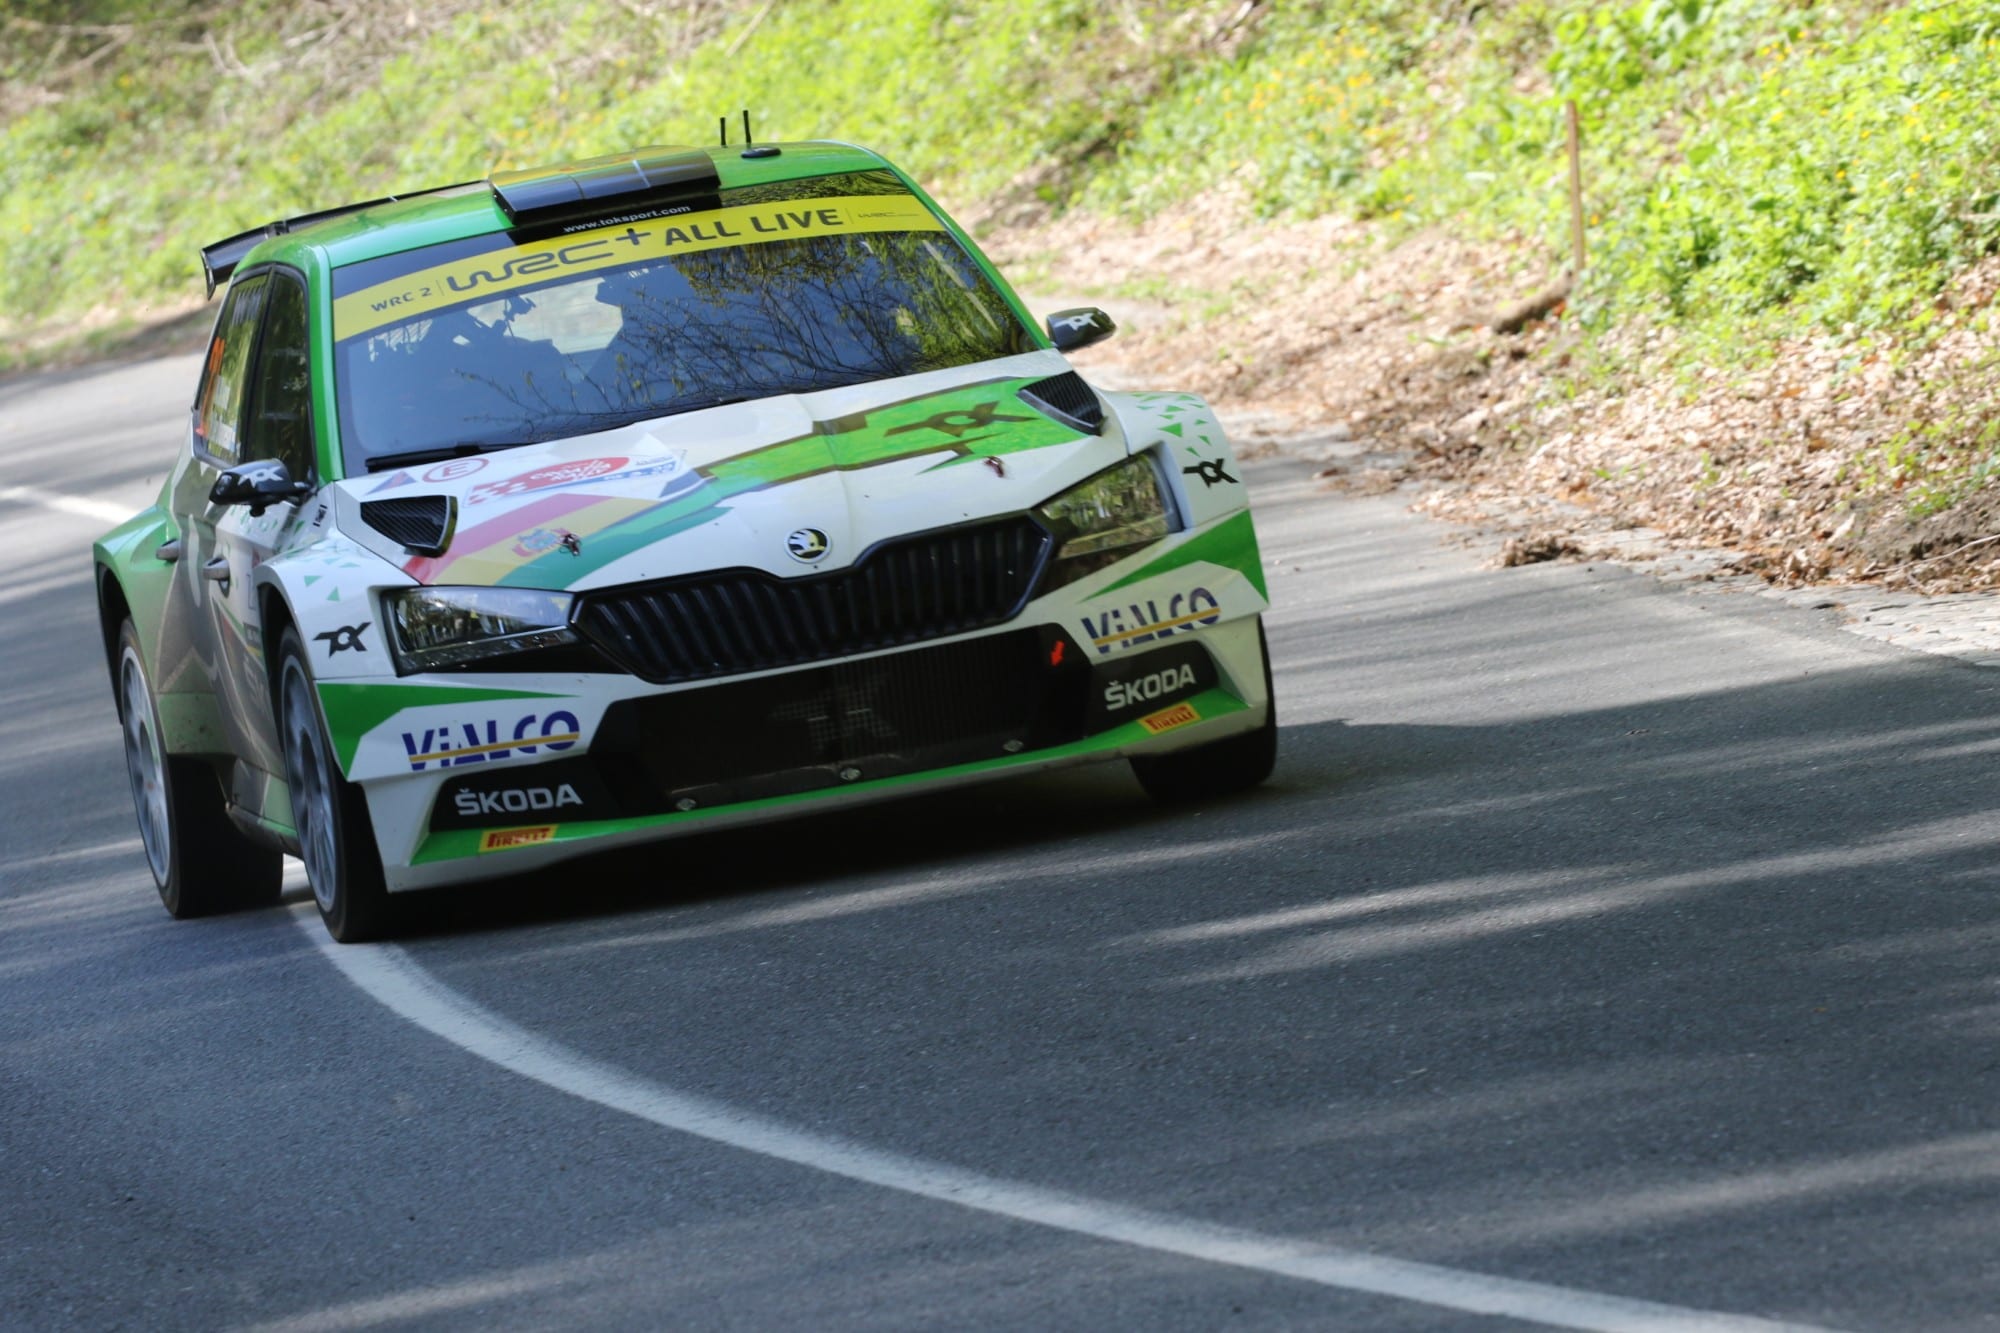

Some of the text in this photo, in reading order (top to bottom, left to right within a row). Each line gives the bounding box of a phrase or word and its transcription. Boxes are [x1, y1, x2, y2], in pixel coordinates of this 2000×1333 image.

[563, 204, 691, 233] www.toksport.com
[665, 221, 741, 246] ALL
[750, 209, 844, 232] LIVE
[371, 287, 432, 312] WRC 2
[1104, 664, 1197, 711] ŠKODA
[455, 784, 583, 816] ŠKODA
